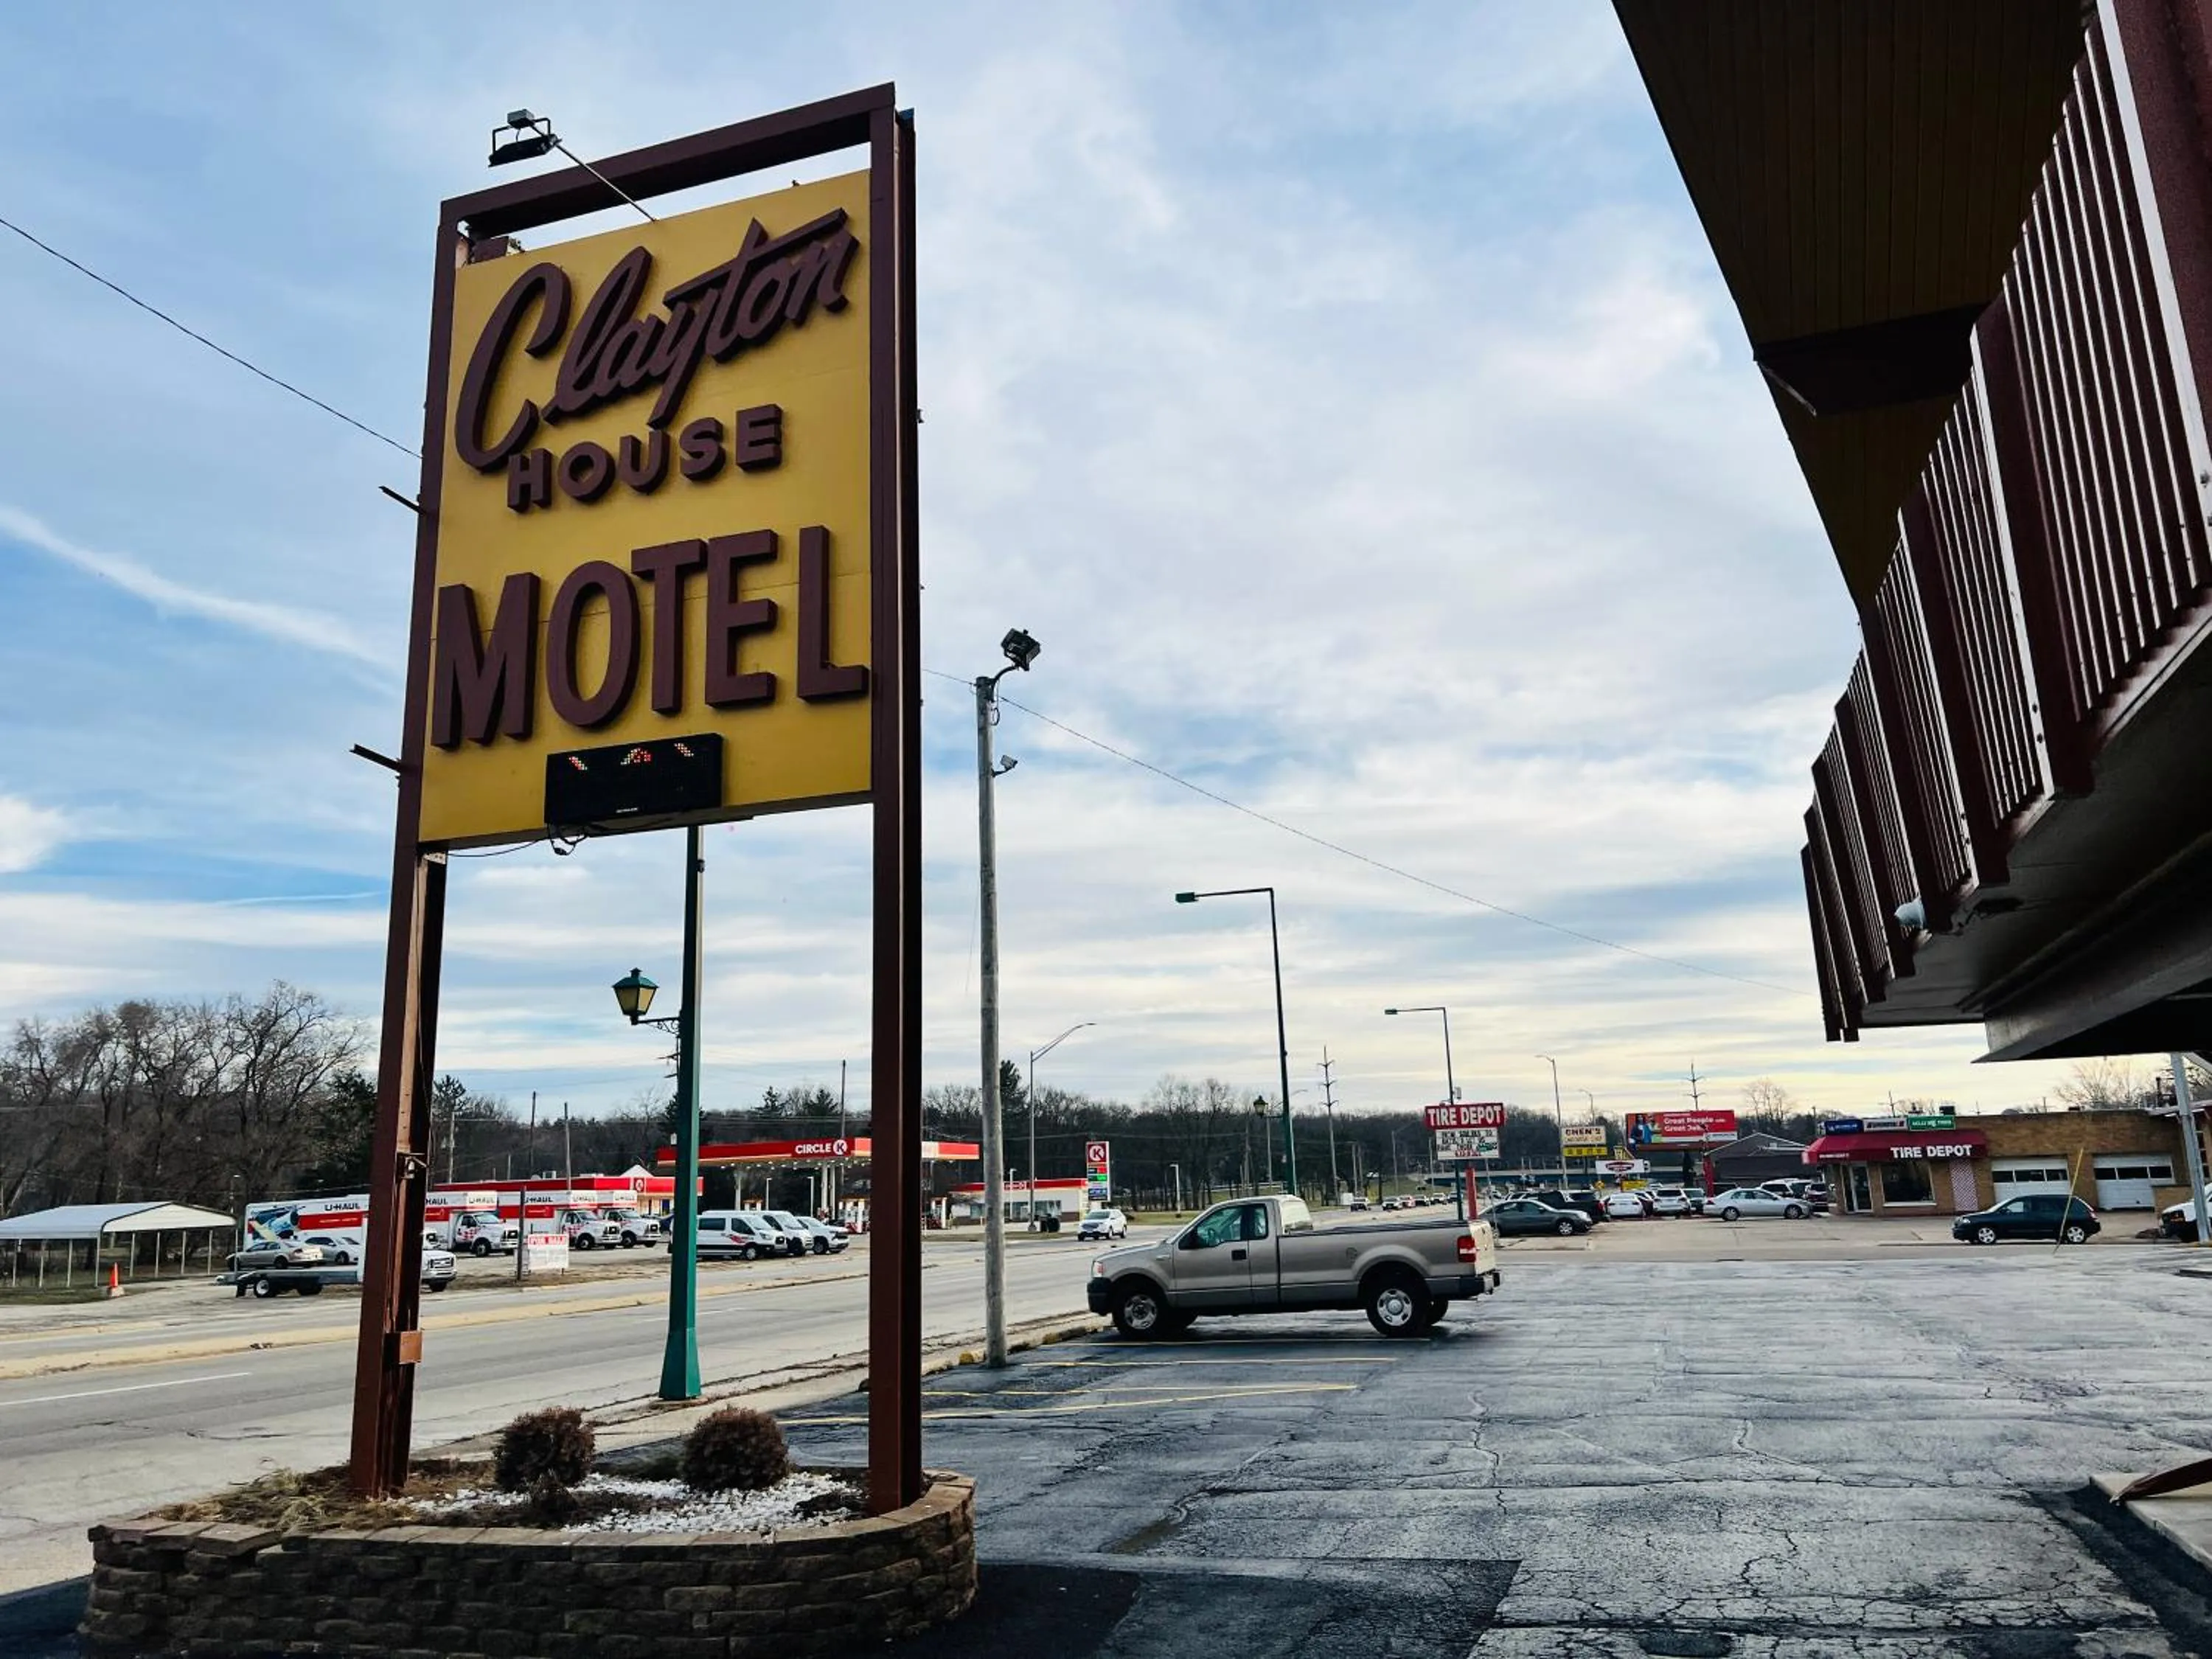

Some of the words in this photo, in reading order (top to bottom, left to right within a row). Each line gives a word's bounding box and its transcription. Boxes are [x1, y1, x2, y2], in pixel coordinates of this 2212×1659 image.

[455, 206, 861, 474] Clayton
[506, 403, 784, 513] HOUSE
[431, 524, 872, 750] MOTEL
[1427, 1107, 1458, 1127] TIRE
[1460, 1105, 1502, 1124] DEPOT
[795, 1143, 832, 1154] CIRCLE
[834, 1140, 847, 1155] K
[1890, 1147, 1922, 1158] TIRE
[1926, 1144, 1972, 1157] DEPOT
[324, 1203, 361, 1211] U-HAUL
[425, 1197, 448, 1205] HAUL
